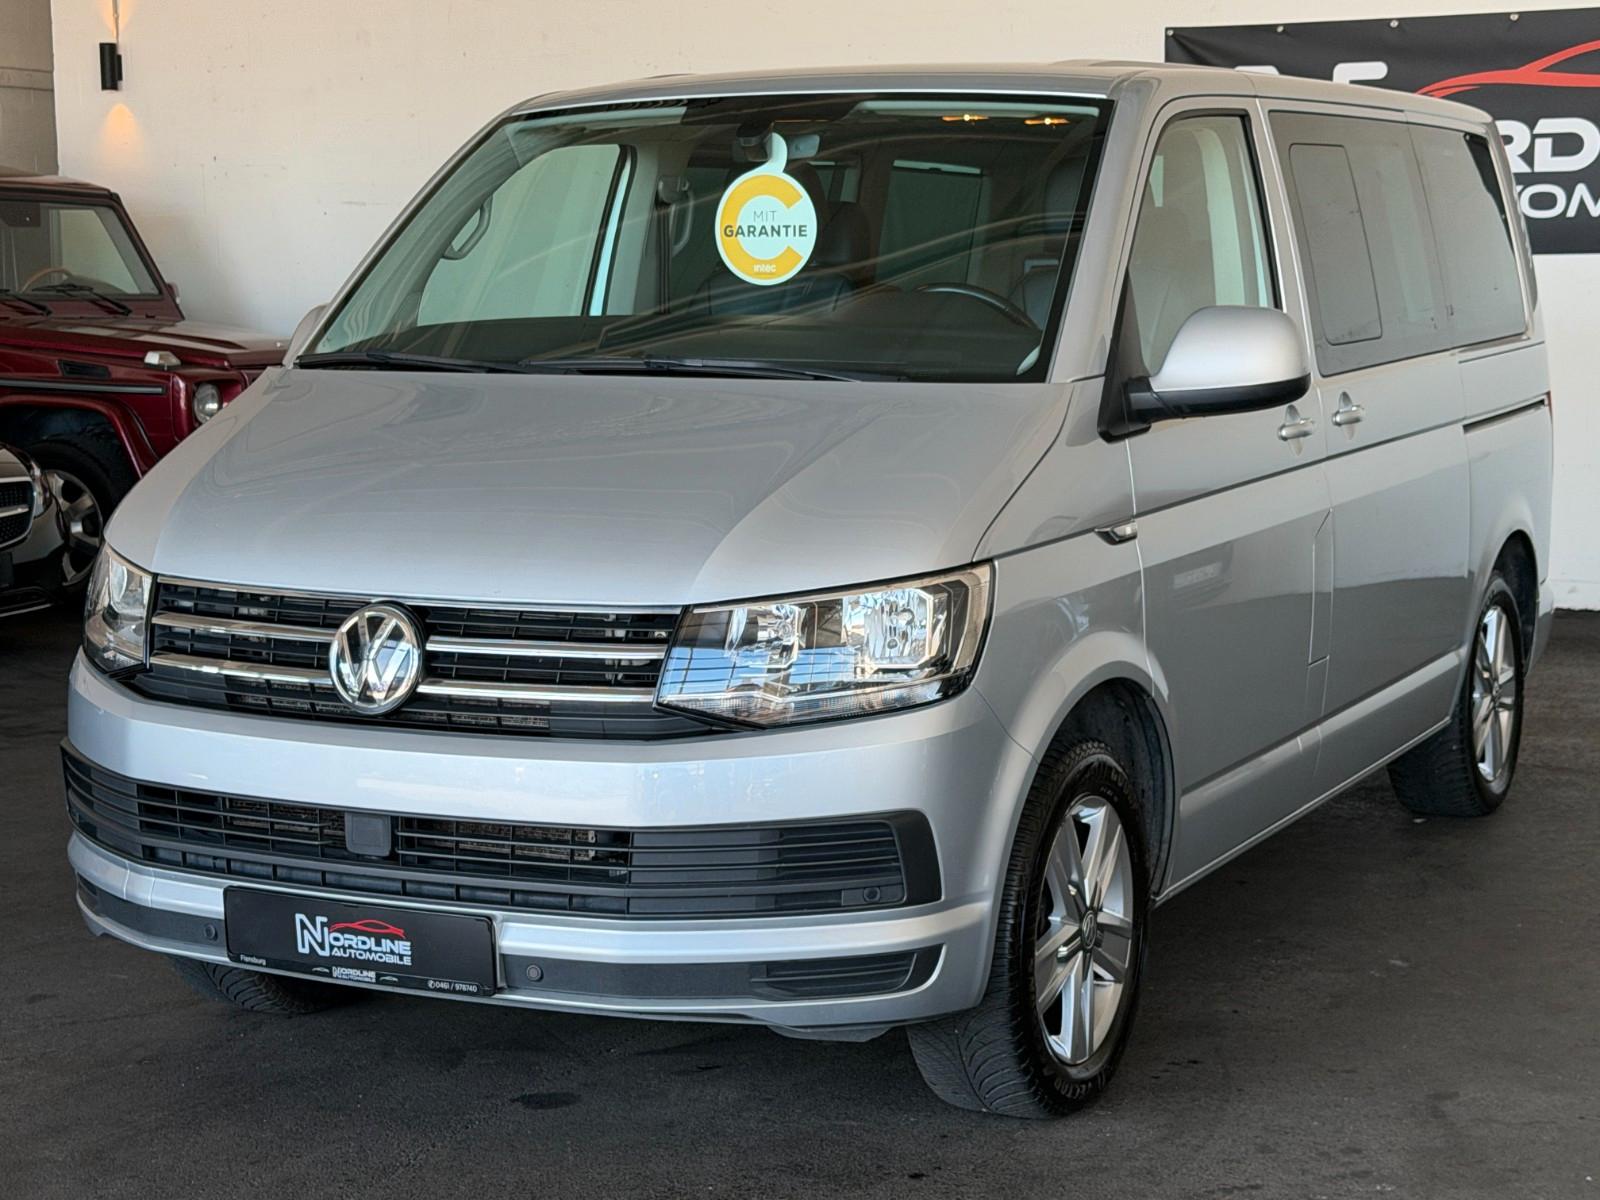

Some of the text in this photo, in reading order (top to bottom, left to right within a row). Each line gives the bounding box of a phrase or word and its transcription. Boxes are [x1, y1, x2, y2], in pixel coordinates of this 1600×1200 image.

[753, 210, 777, 222] MIT
[723, 224, 808, 238] GARANTIE
[295, 913, 412, 957] NORDLINE
[331, 947, 412, 966] AUTOMOBILE
